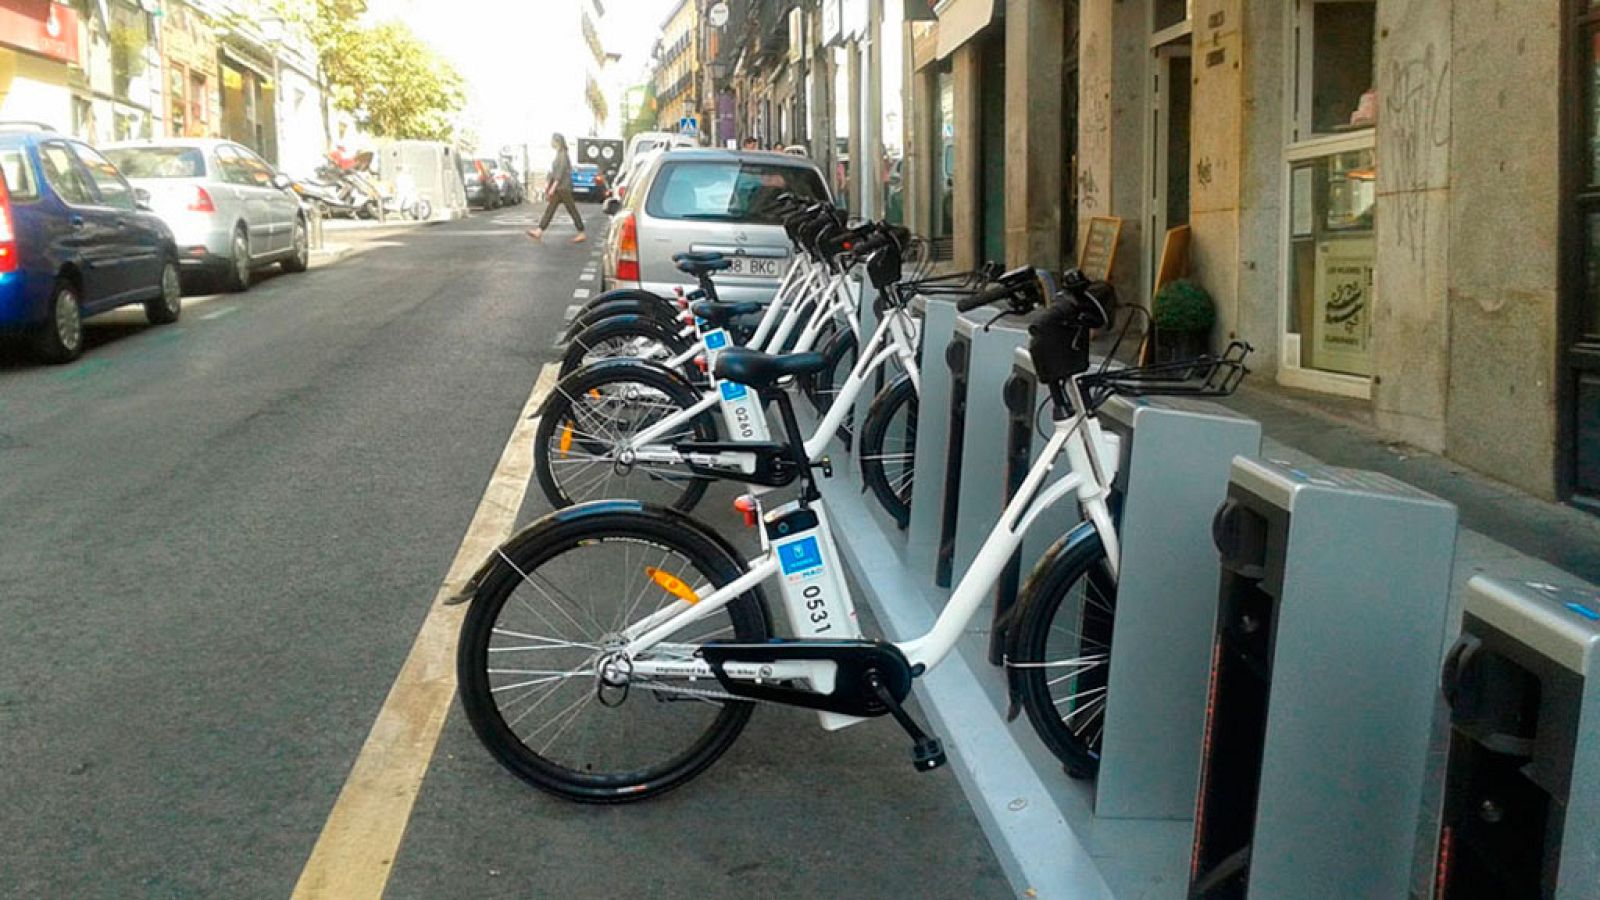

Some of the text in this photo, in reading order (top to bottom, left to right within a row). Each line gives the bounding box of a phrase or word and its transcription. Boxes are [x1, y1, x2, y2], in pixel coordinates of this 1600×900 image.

[750, 260, 776, 274] BKC
[735, 407, 754, 438] 0260
[802, 585, 832, 634] 0531
